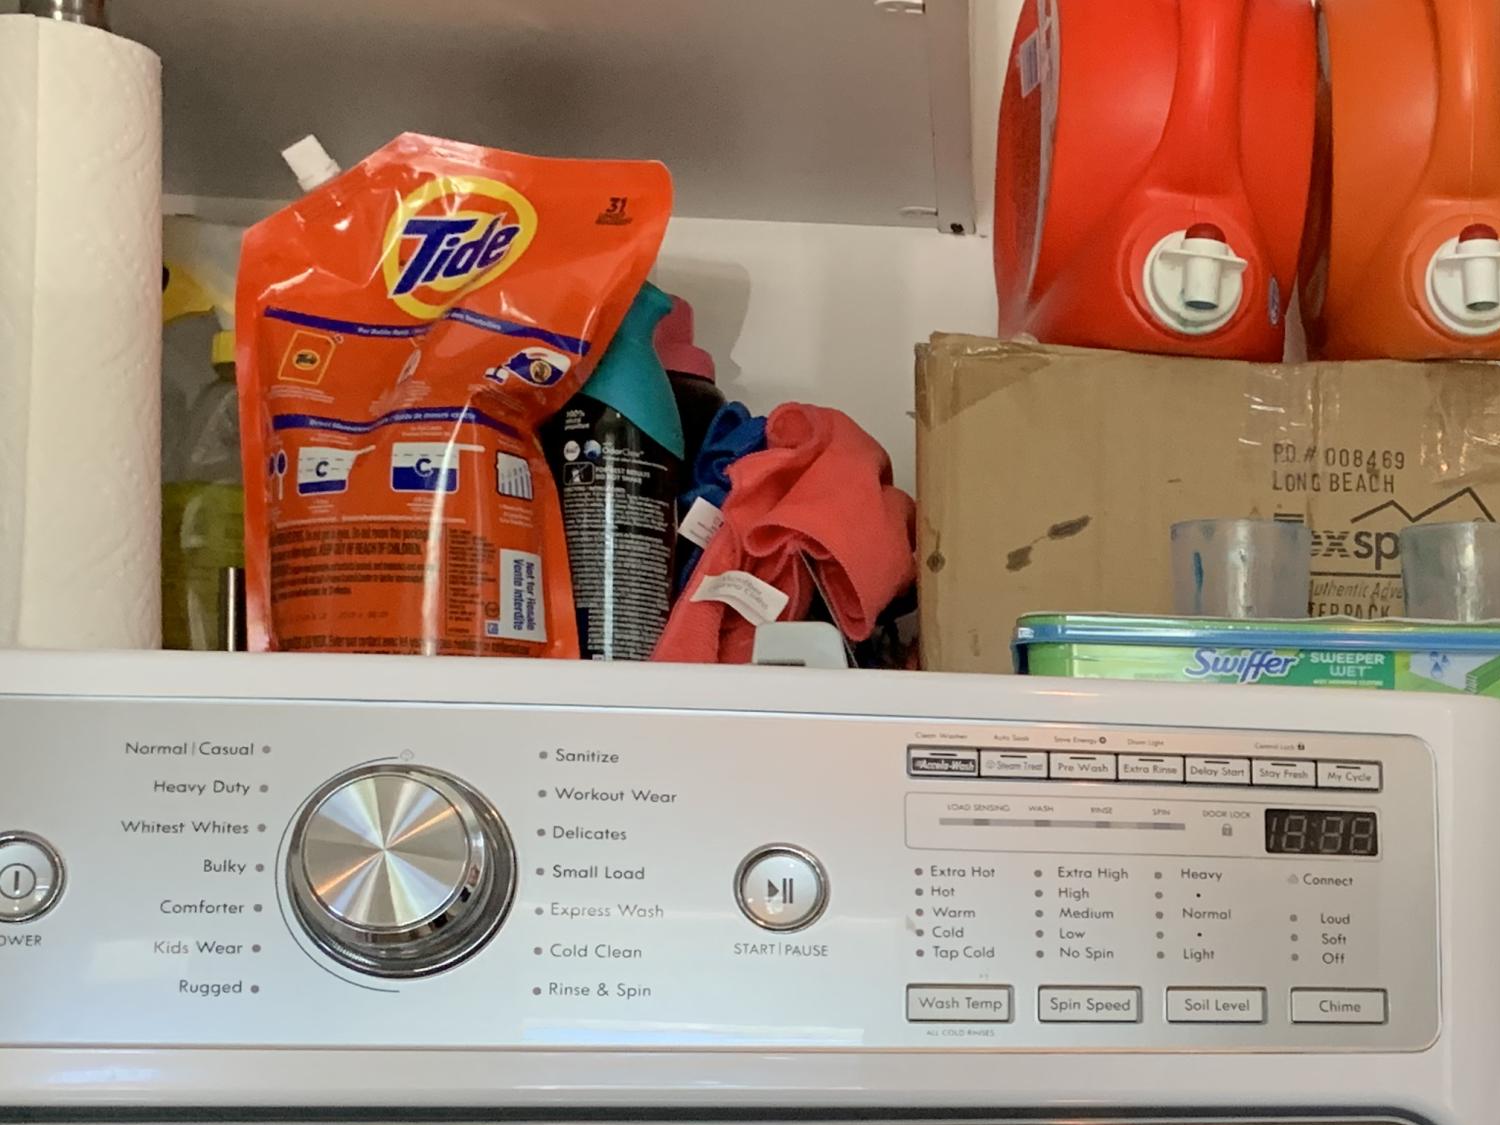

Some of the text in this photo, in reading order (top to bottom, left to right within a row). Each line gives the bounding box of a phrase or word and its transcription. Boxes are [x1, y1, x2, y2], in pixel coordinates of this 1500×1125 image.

[390, 214, 521, 297] Tide
[1326, 447, 1405, 470] 008469
[1272, 470, 1394, 494] LONG BEACH
[1310, 580, 1403, 600] uthentic Adve
[1186, 648, 1386, 683] Swiffer SWEEPER
[1329, 666, 1366, 678] WET
[126, 742, 253, 755] Normal Casual
[556, 749, 619, 763] Sanitize
[1058, 763, 1108, 772] Pre Wash
[1124, 764, 1177, 774] Extra Rinse
[1190, 766, 1244, 776] Delay Start
[1260, 768, 1308, 779] Stay Fresh
[1328, 772, 1371, 782] My Cycle
[154, 780, 250, 795] Heavy Duty
[555, 788, 677, 802] Workout Wear
[121, 821, 248, 834] Whitest Whites
[553, 826, 626, 840] Delicates
[204, 859, 246, 874] Bulky
[553, 865, 644, 879] Small Load
[931, 865, 995, 877] Extra Hot
[1058, 866, 1128, 882] Extra High
[1181, 869, 1222, 881] Heavy
[1303, 873, 1353, 886] Connect
[931, 886, 955, 897] Hot
[1059, 888, 1089, 901] High
[160, 900, 244, 913] Comforter
[551, 902, 663, 919] Express Wash
[933, 907, 975, 918] Warm
[1060, 908, 1113, 919] Medium
[1183, 908, 1231, 920] Normal
[1321, 913, 1350, 924] Loud
[932, 926, 964, 938] Cold
[1060, 928, 1085, 939] Low
[1322, 933, 1346, 945] Soft
[154, 941, 242, 954] Kids Wear
[550, 944, 641, 958] Cold Clean
[734, 943, 828, 956] START PAUSE
[933, 946, 995, 960] Tap Cold
[1060, 947, 1114, 961] No Spin
[1184, 949, 1214, 962] Light
[1322, 952, 1344, 964] Off
[179, 980, 242, 997] Rugged
[549, 982, 590, 996] Rinse
[617, 983, 651, 1000] Spin
[919, 997, 1002, 1012] Wash Temp
[1050, 997, 1130, 1012] Spin Speed
[1185, 998, 1249, 1011] Soil Level
[1319, 1000, 1361, 1012] Chime
